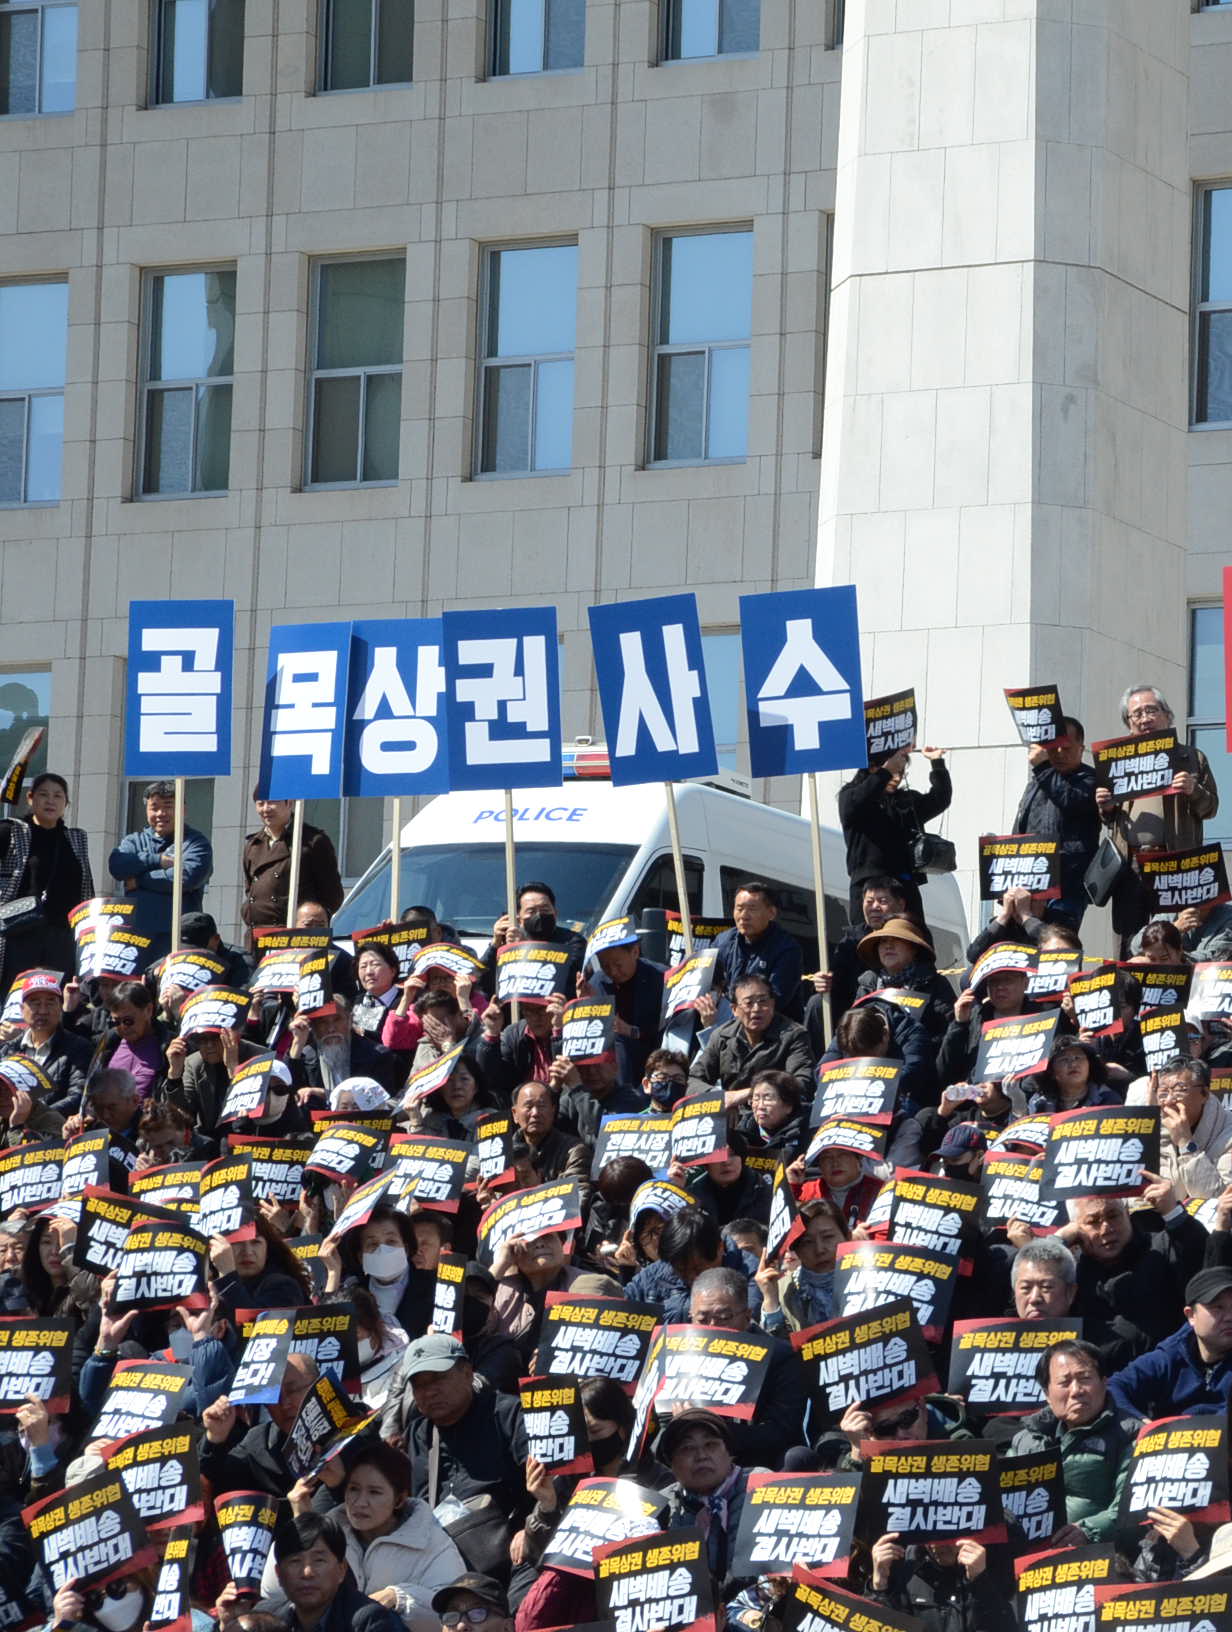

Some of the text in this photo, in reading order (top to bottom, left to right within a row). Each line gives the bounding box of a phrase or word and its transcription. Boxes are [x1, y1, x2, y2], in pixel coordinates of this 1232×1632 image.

[138, 628, 221, 752] 골
[616, 624, 700, 757] 사
[758, 618, 851, 750] 수
[271, 650, 337, 775] 목
[353, 645, 446, 775] 상
[456, 635, 550, 765] 권
[1099, 737, 1174, 762] 골목상권 생존위협
[1108, 753, 1169, 777] 새벽배송
[1113, 771, 1173, 797] 결사반대
[473, 808, 587, 823] POLICE
[983, 842, 1056, 855] 골목상권 생존위협
[1143, 851, 1219, 872] 골목상권 생존위협
[988, 857, 1048, 875] 새벽배송
[990, 873, 1051, 892] 결사반대
[1152, 869, 1215, 890] 새벽배송
[1158, 882, 1219, 905] 결사반대
[257, 936, 329, 948] 골목상권 생존위협
[527, 951, 568, 963] 생존위협
[984, 1017, 1056, 1041] 골목상권 생존위협
[987, 1033, 1045, 1057] 새벽배송
[821, 1067, 897, 1081] 골목상권 생존위협
[984, 1049, 1043, 1075] 결사반대
[825, 1081, 885, 1099] 새벽배송
[819, 1096, 884, 1115] 결사반대
[606, 1133, 669, 1150] 전통시장
[1051, 1119, 1155, 1139] 골목상권 생존위협
[1054, 1138, 1144, 1163] 새벽배송
[1053, 1163, 1146, 1188] 결사반대
[895, 1181, 977, 1211] 골목상권 생존위협
[155, 1231, 206, 1254] 생존위협
[118, 1250, 197, 1277] 새벽배송
[840, 1253, 953, 1279] 골목상권 생존위협
[115, 1272, 197, 1300] 결사반대
[846, 1271, 935, 1300] 새벽배송
[547, 1305, 657, 1331] 골목상권 생존위협
[550, 1325, 641, 1356] 새벽배송
[801, 1311, 911, 1361] 골목상권 생존위협
[959, 1332, 1016, 1348] 골목상권
[549, 1349, 640, 1382] 결사반대
[818, 1337, 907, 1385] 새벽배송
[826, 1360, 916, 1411] 결사반대
[1168, 1430, 1221, 1448] 생존위협
[871, 1453, 990, 1472] 골목상권 생존위협
[1132, 1452, 1209, 1483] 새벽배송
[752, 1485, 856, 1504] 골목상권 생존위협
[882, 1477, 982, 1503] 새벽배송
[1130, 1481, 1212, 1511] 결사반대
[31, 1482, 122, 1538] 골목상권 생존위협
[753, 1509, 841, 1536] 새벽배송
[886, 1505, 986, 1531] 결사반대
[42, 1509, 121, 1561] 새벽배송
[599, 1541, 700, 1577] 골목상권 생존위협
[750, 1537, 838, 1563] 결사반대
[49, 1537, 132, 1590] 결사반대
[1019, 1559, 1110, 1590] 골목상권 생존위협
[609, 1566, 692, 1607] 새벽배송
[614, 1595, 697, 1632] 결사반대
[1101, 1592, 1228, 1618] 골목상권 생존위협
